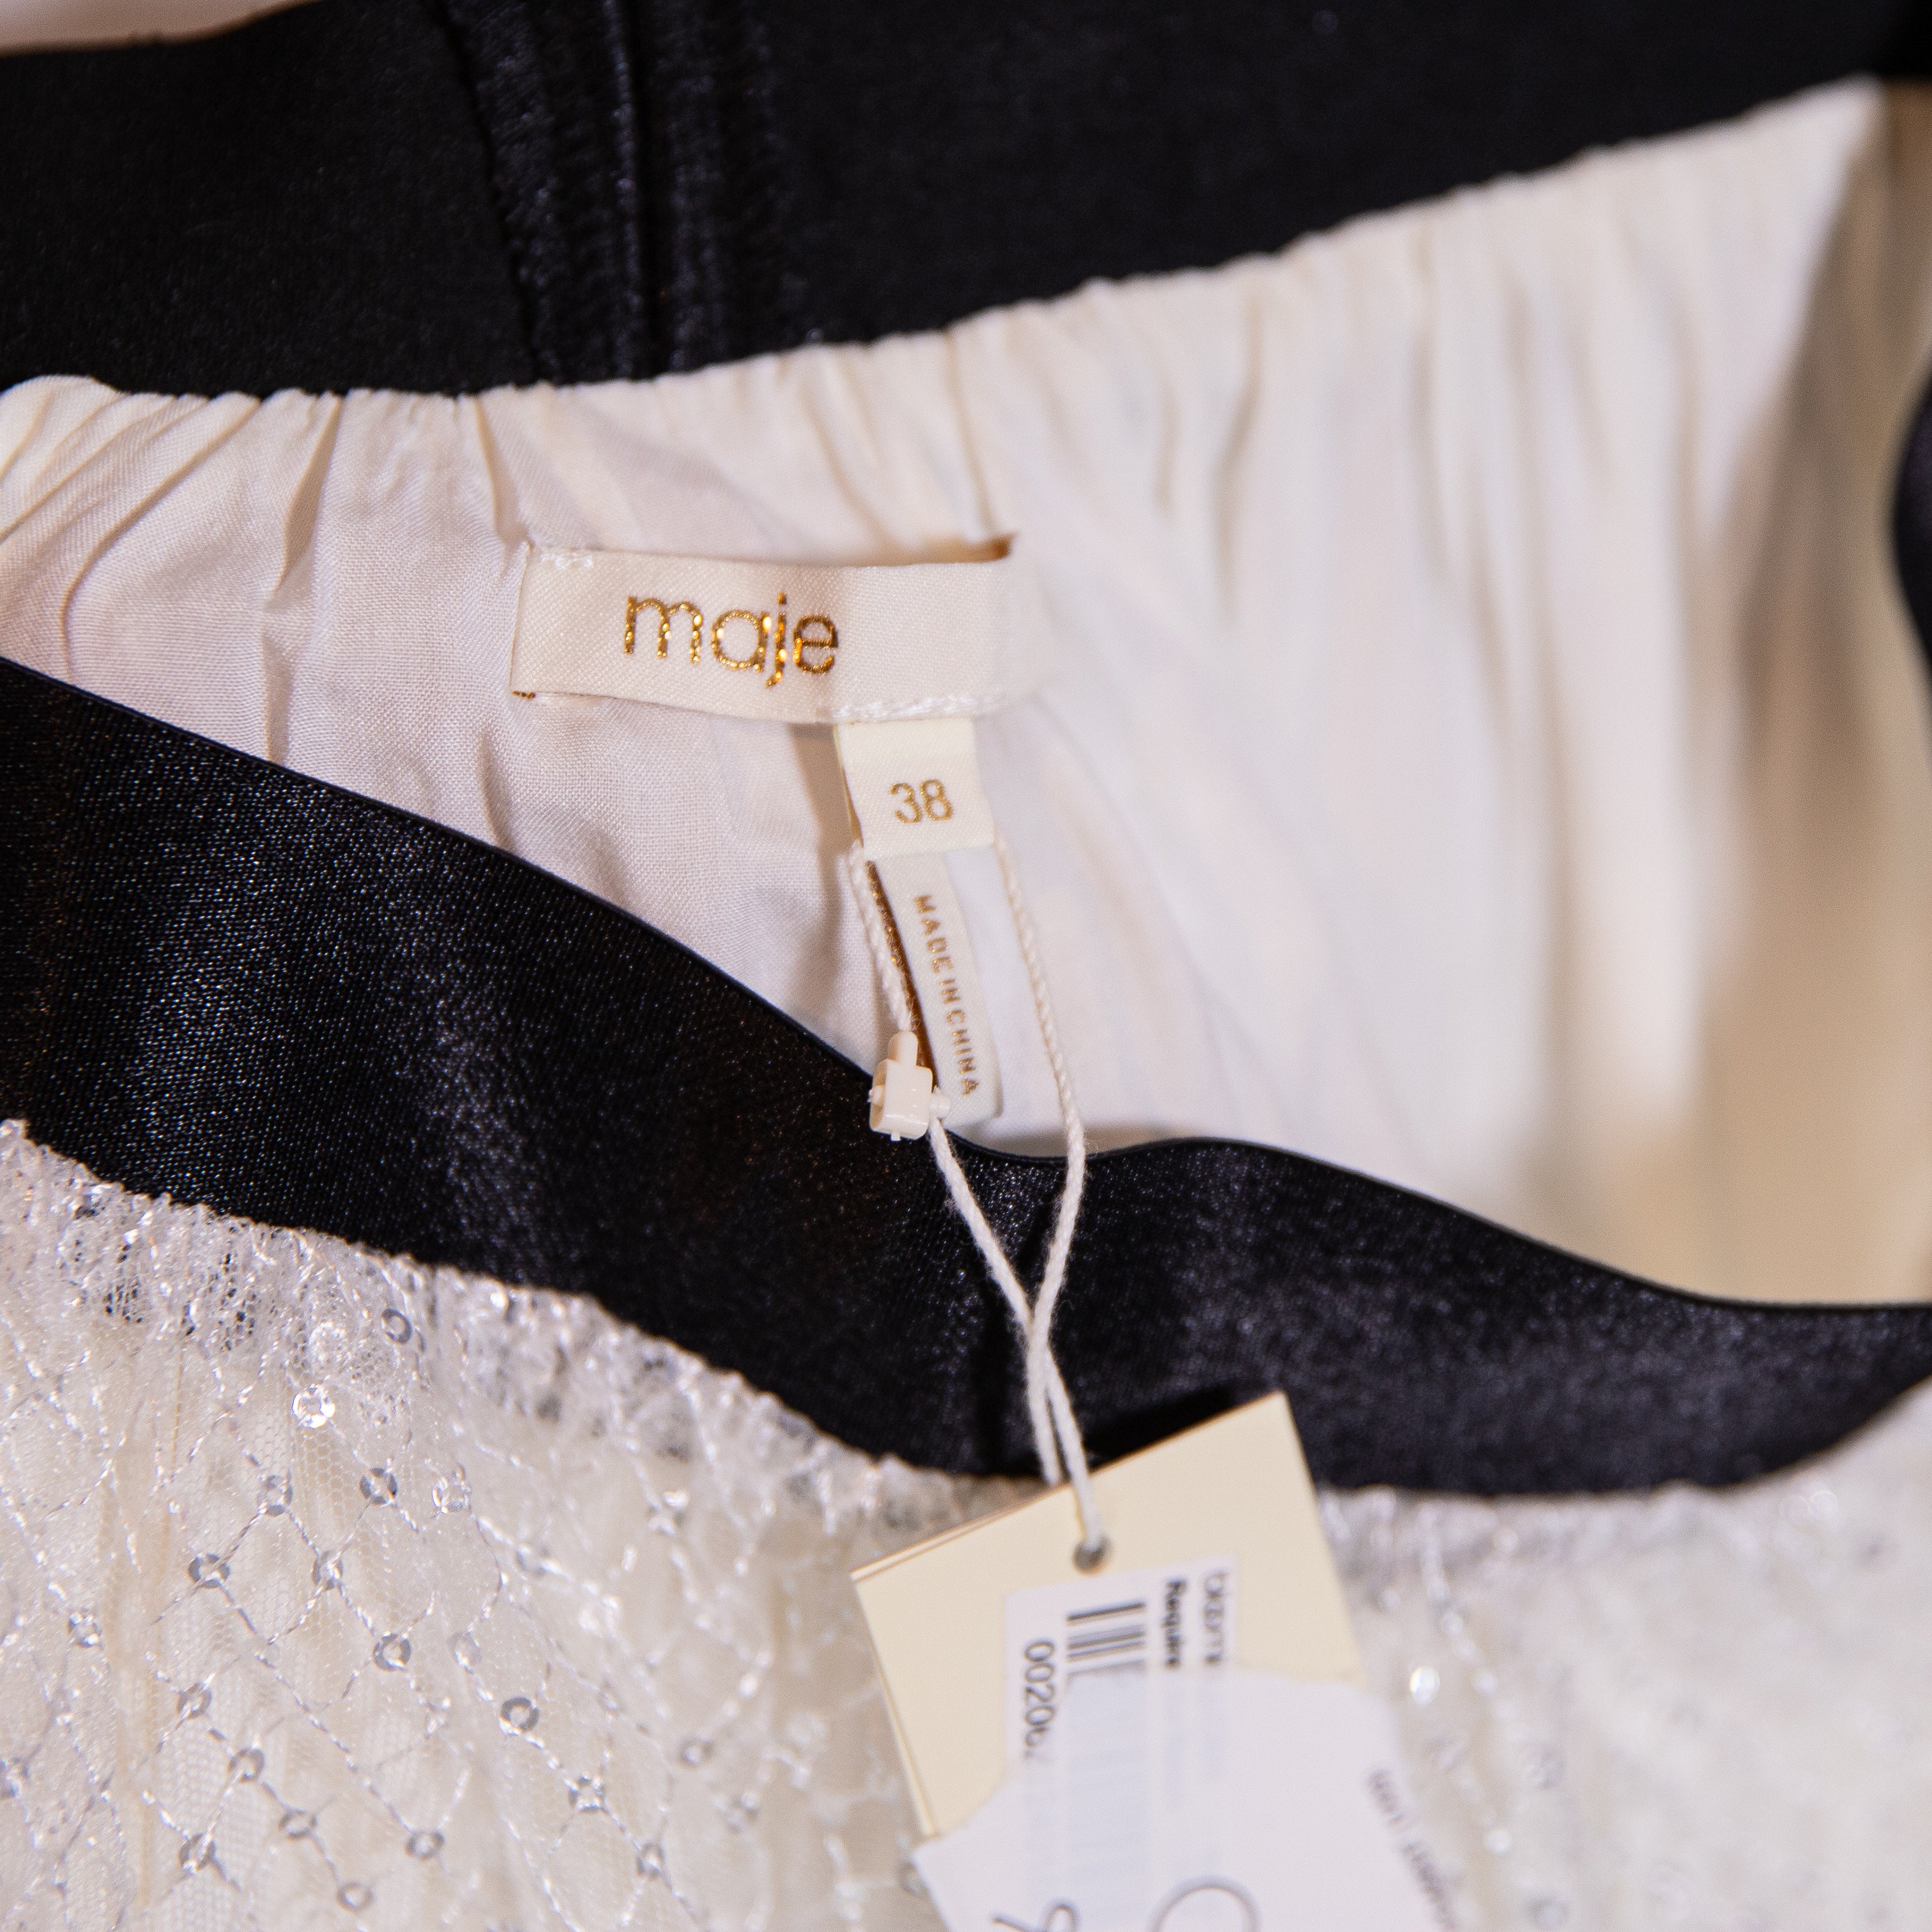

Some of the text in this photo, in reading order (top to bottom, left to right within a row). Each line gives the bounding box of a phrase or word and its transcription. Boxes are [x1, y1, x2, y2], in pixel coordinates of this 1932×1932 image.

[624, 592, 839, 688] maje
[889, 778, 954, 824] 38
[913, 894, 980, 1097] MADE IN CHINA
